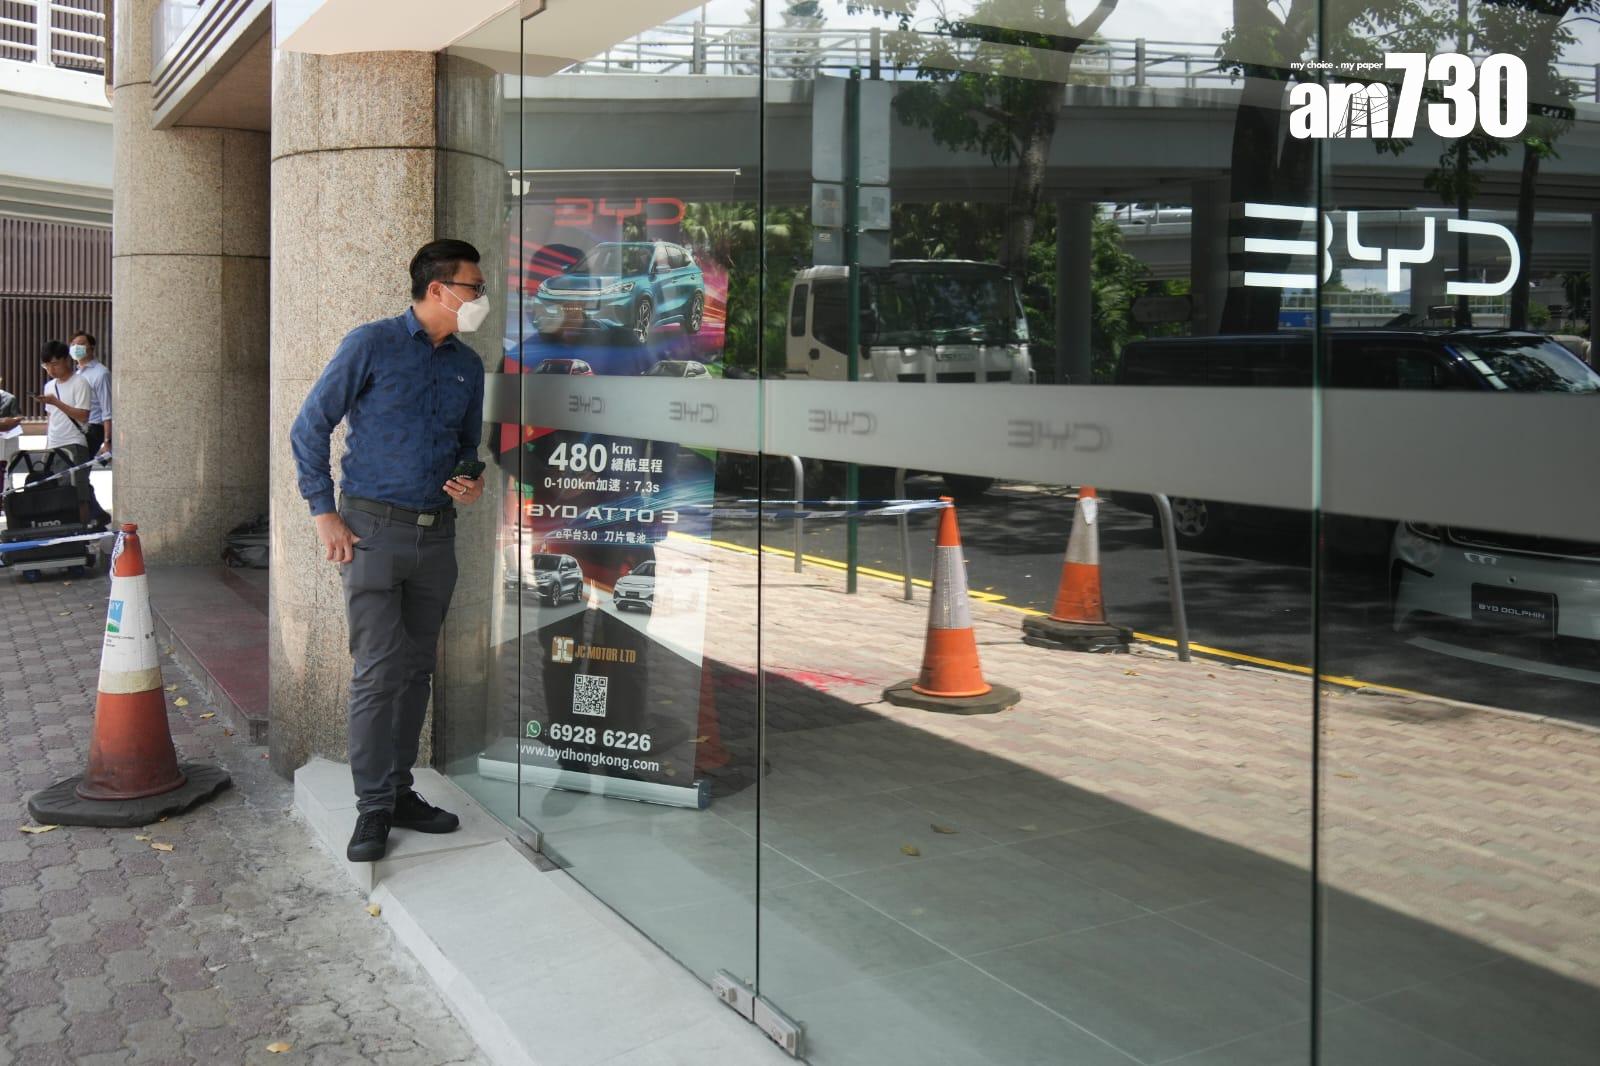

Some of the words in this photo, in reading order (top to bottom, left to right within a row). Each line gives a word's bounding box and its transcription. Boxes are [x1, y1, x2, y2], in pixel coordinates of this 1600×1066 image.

[554, 197, 686, 226] BYD
[1244, 202, 1521, 297] BYD
[548, 442, 608, 473] 480
[612, 442, 633, 455] km
[610, 457, 663, 473] 續航里程
[527, 504, 578, 519] BYD
[586, 506, 655, 523] ATTO
[661, 510, 679, 524] 3
[555, 528, 598, 541] e平台3.0
[604, 530, 647, 544] 刀片電池
[1478, 603, 1499, 612] BYD
[1501, 607, 1545, 619] DOLPHIN
[575, 645, 586, 658] JC
[587, 646, 618, 662] MOTOR
[620, 649, 636, 663] LTD
[550, 723, 597, 745] 6928
[602, 729, 652, 752] 6226
[516, 743, 660, 772] www.bydhongkong.com
